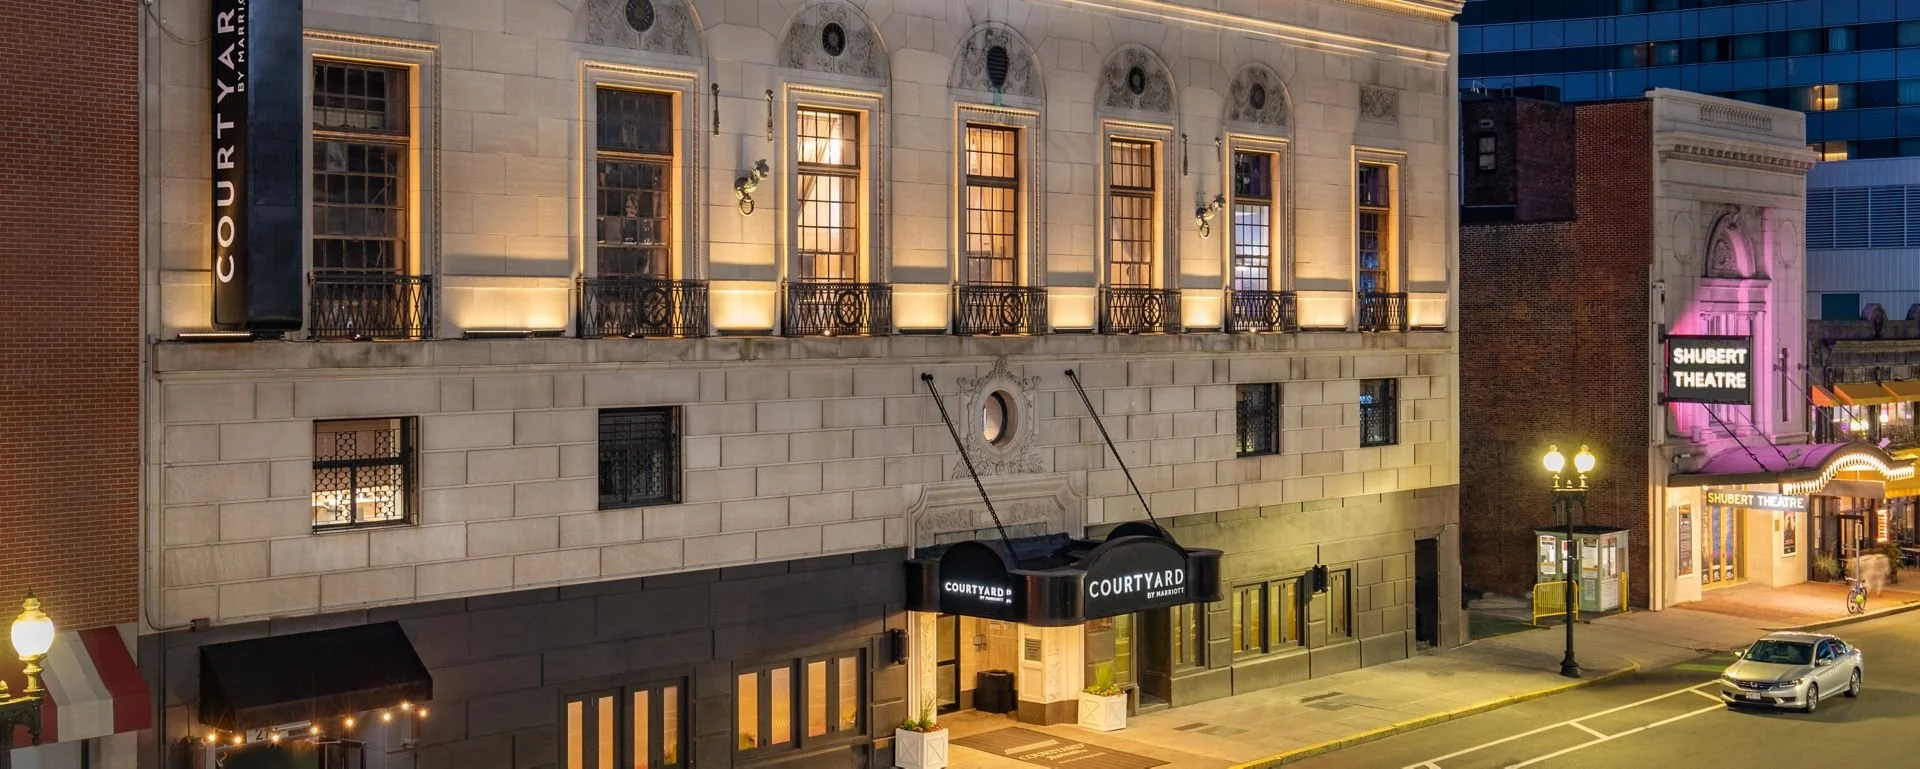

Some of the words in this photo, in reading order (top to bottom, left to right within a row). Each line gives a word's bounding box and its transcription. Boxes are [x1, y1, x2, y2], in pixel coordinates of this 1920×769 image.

[237, 72, 245, 93] BY
[1673, 347, 1748, 365] SHUBERT
[1673, 371, 1747, 389] THEATRE
[1707, 492, 1754, 506] SHUBERT
[1757, 494, 1804, 509] THEATRE
[944, 582, 1004, 597] COURTYARD
[1089, 568, 1184, 598] COURTYARD
[1147, 591, 1155, 599] BY
[1156, 587, 1185, 597] MARRIOTT
